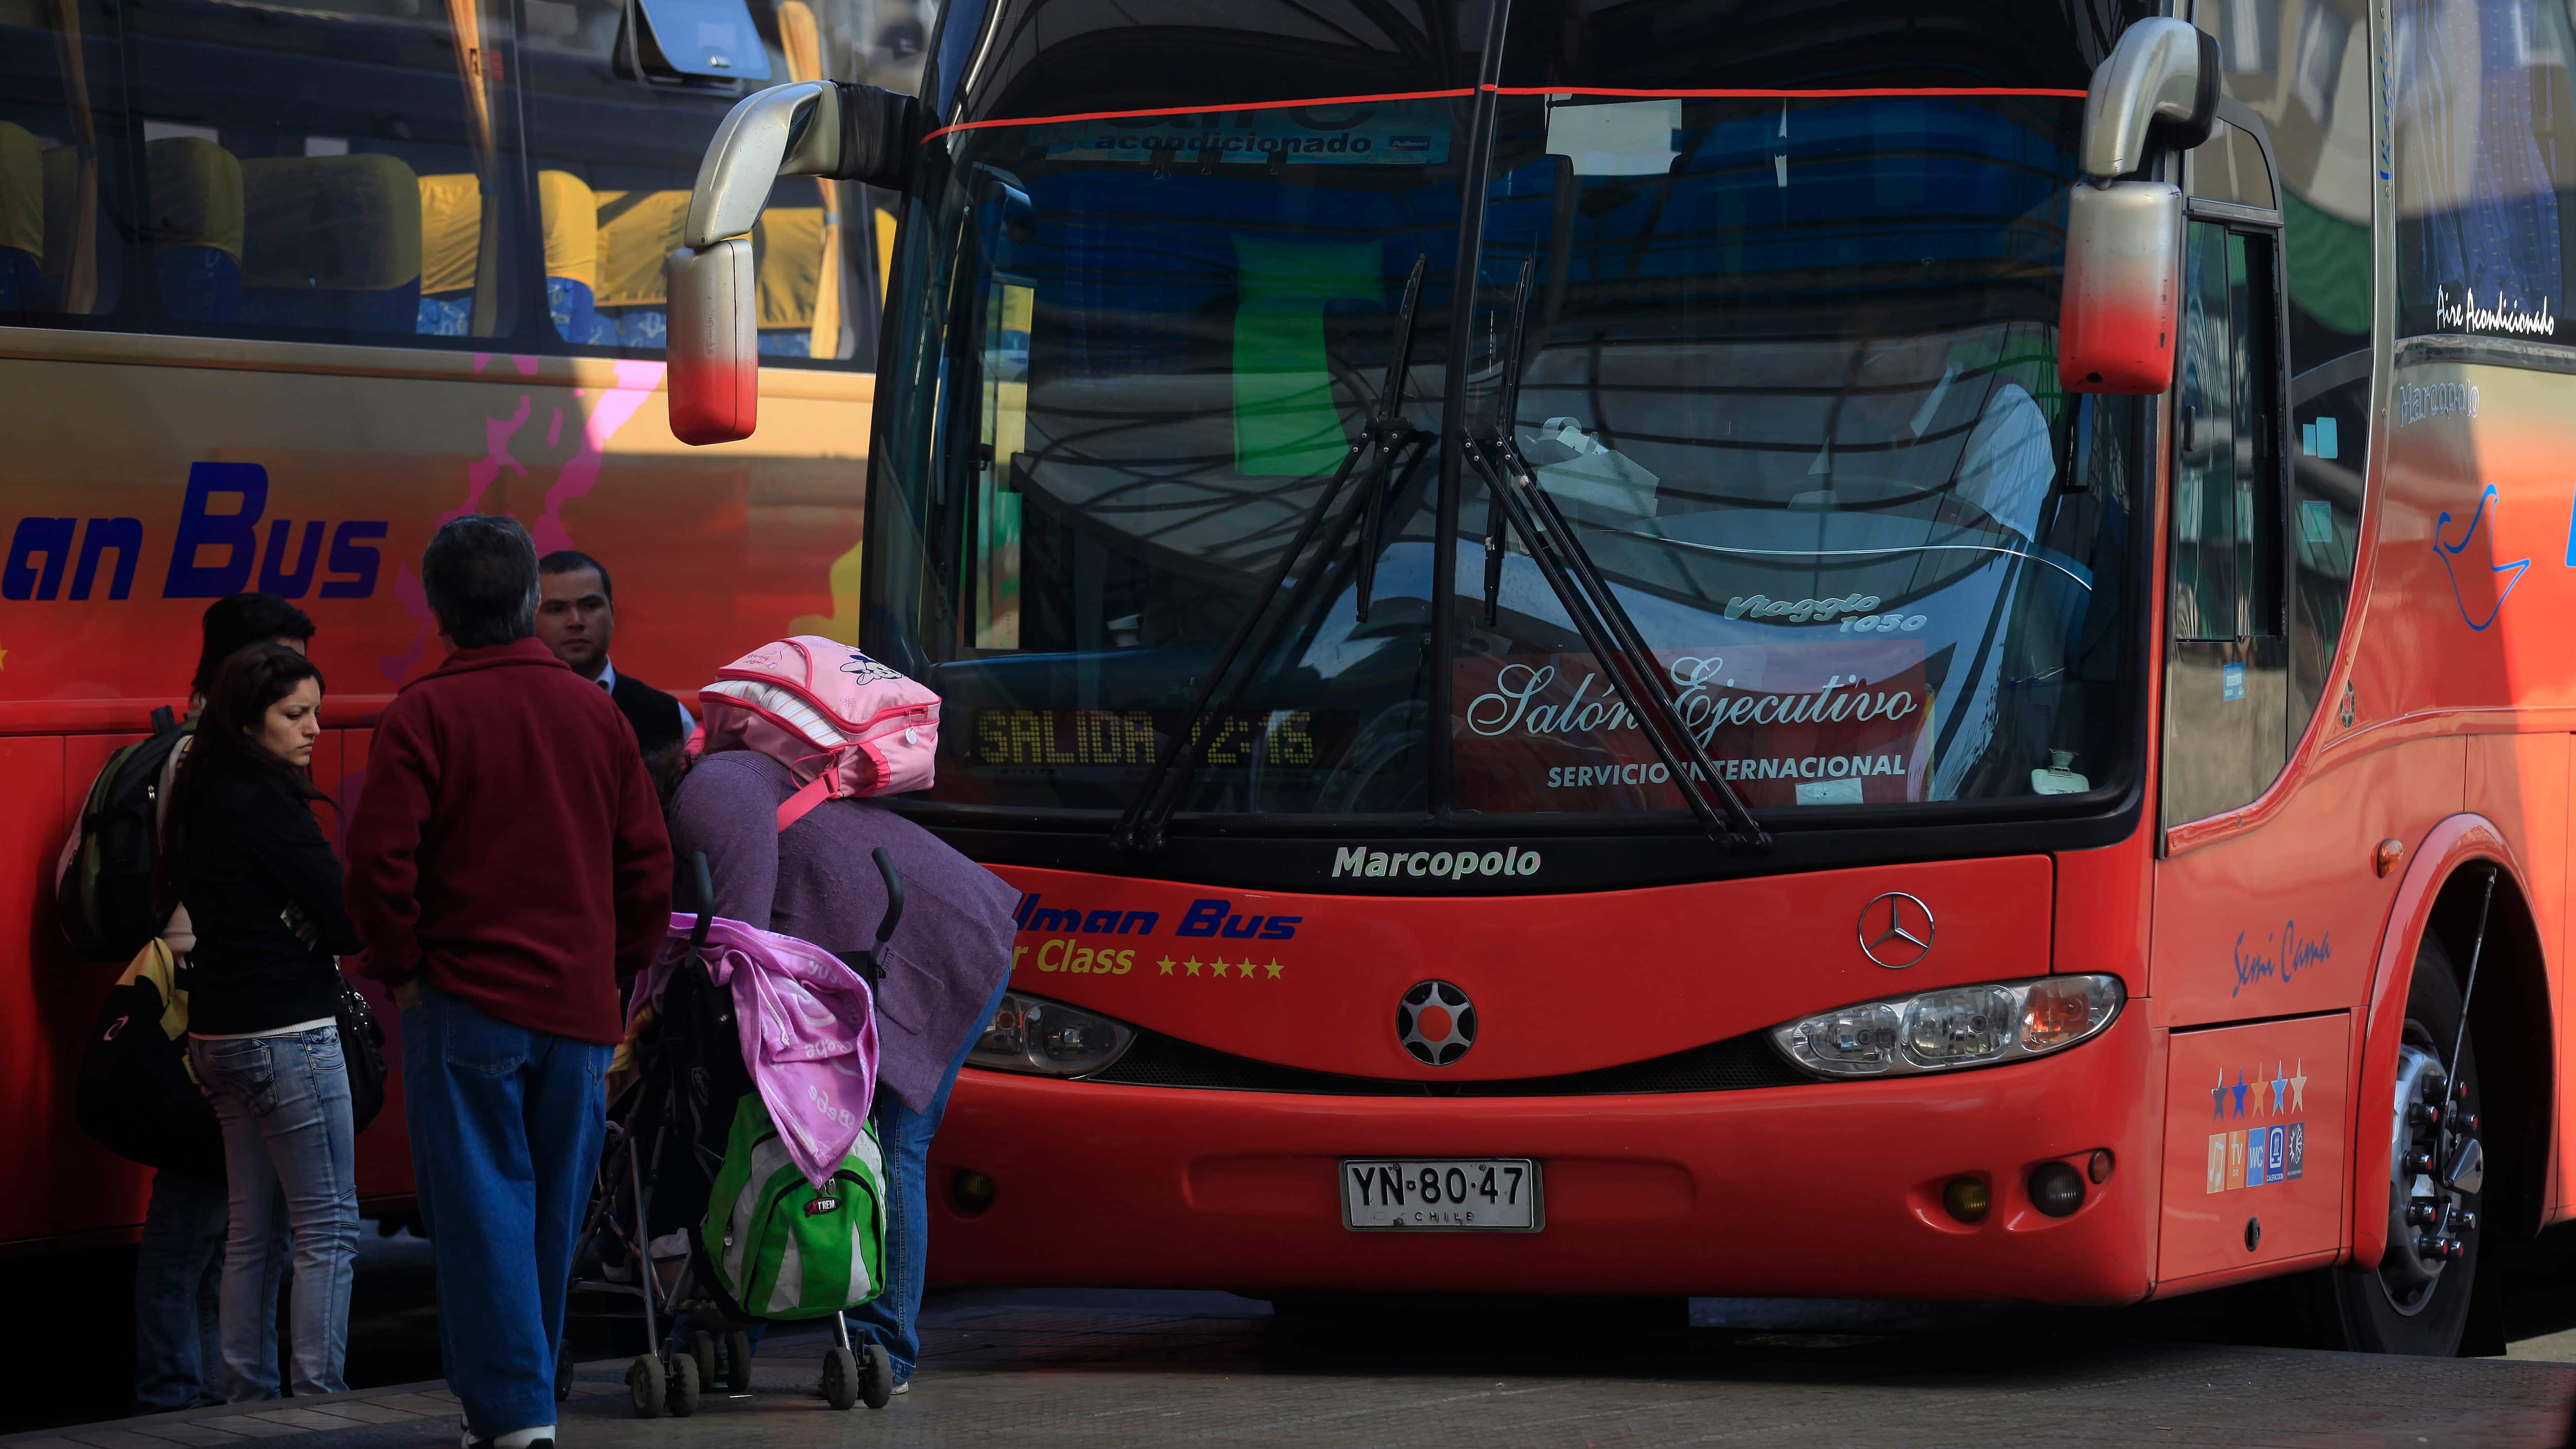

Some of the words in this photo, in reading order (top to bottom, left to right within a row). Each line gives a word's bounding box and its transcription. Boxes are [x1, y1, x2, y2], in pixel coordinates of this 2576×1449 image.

[2437, 284, 2463, 330] Aire
[2465, 287, 2555, 335] Acondicionado
[2399, 378, 2480, 428] Marcopolo
[1724, 593, 1880, 622] Viaggio
[1840, 614, 1927, 633] 1050
[1467, 663, 1639, 736] Salón
[1670, 656, 1918, 749] Ejecutivo
[979, 709, 1156, 764] SALIDA
[1547, 762, 1670, 788] SERVICIO
[1332, 846, 1541, 880] Marcopolo
[1037, 939, 1136, 975] Class
[2231, 1143, 2243, 1165] TV
[2249, 1145, 2263, 1169] WC
[1415, 1211, 1475, 1222] CHILE
